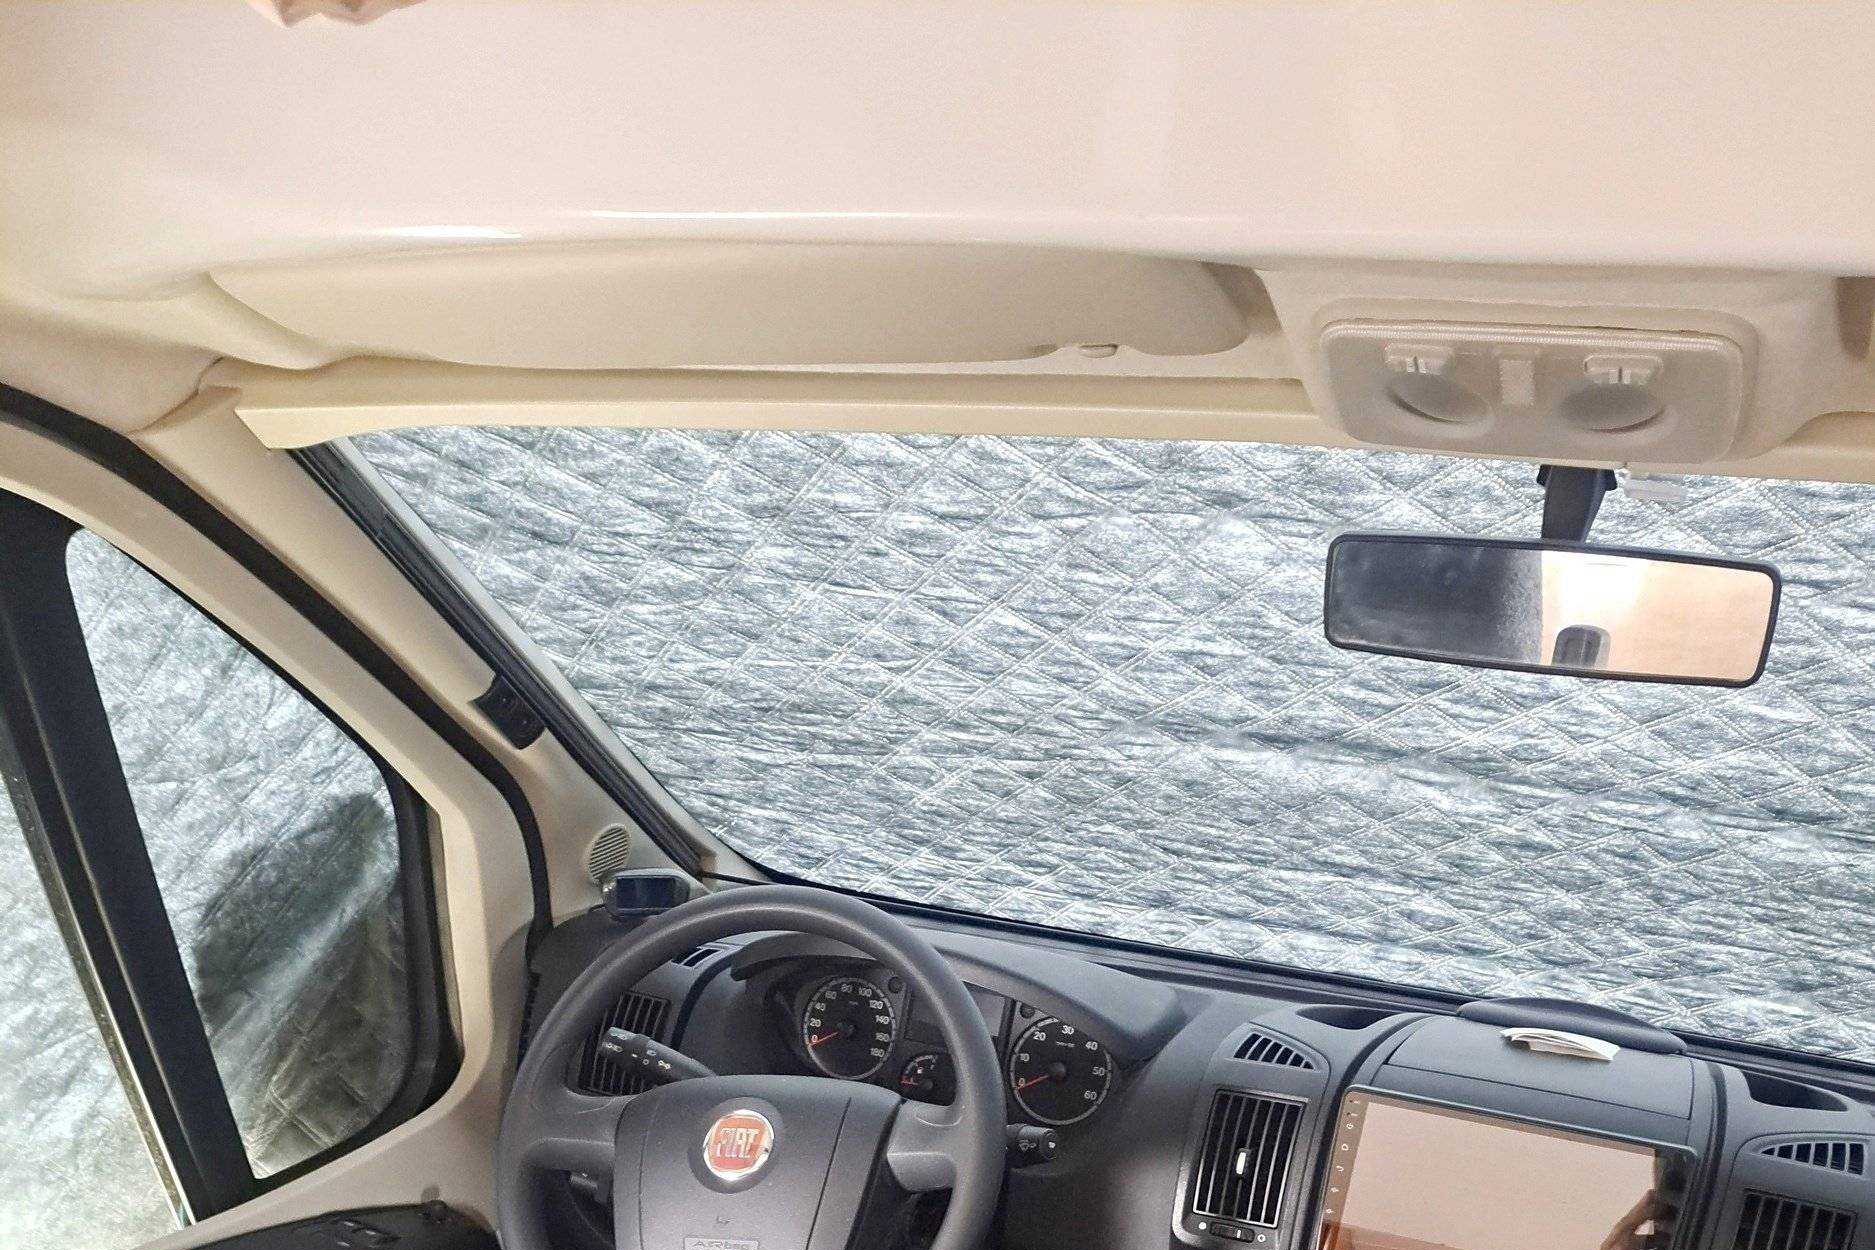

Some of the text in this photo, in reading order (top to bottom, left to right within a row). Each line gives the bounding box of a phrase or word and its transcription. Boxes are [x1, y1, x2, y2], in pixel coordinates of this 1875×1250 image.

[815, 1003, 826, 1011] 40
[869, 1000, 883, 1009] 120
[810, 1018, 821, 1027] 20
[876, 1015, 890, 1024] 140
[1062, 1025, 1074, 1034] 30
[1033, 1032, 1046, 1041] 20
[1085, 1042, 1098, 1050] 40
[1020, 1053, 1030, 1061] 10
[1093, 1067, 1105, 1076] 50
[1019, 1078, 1025, 1086] 0
[1084, 1091, 1097, 1100] 60
[716, 1128, 760, 1158] FIAT
